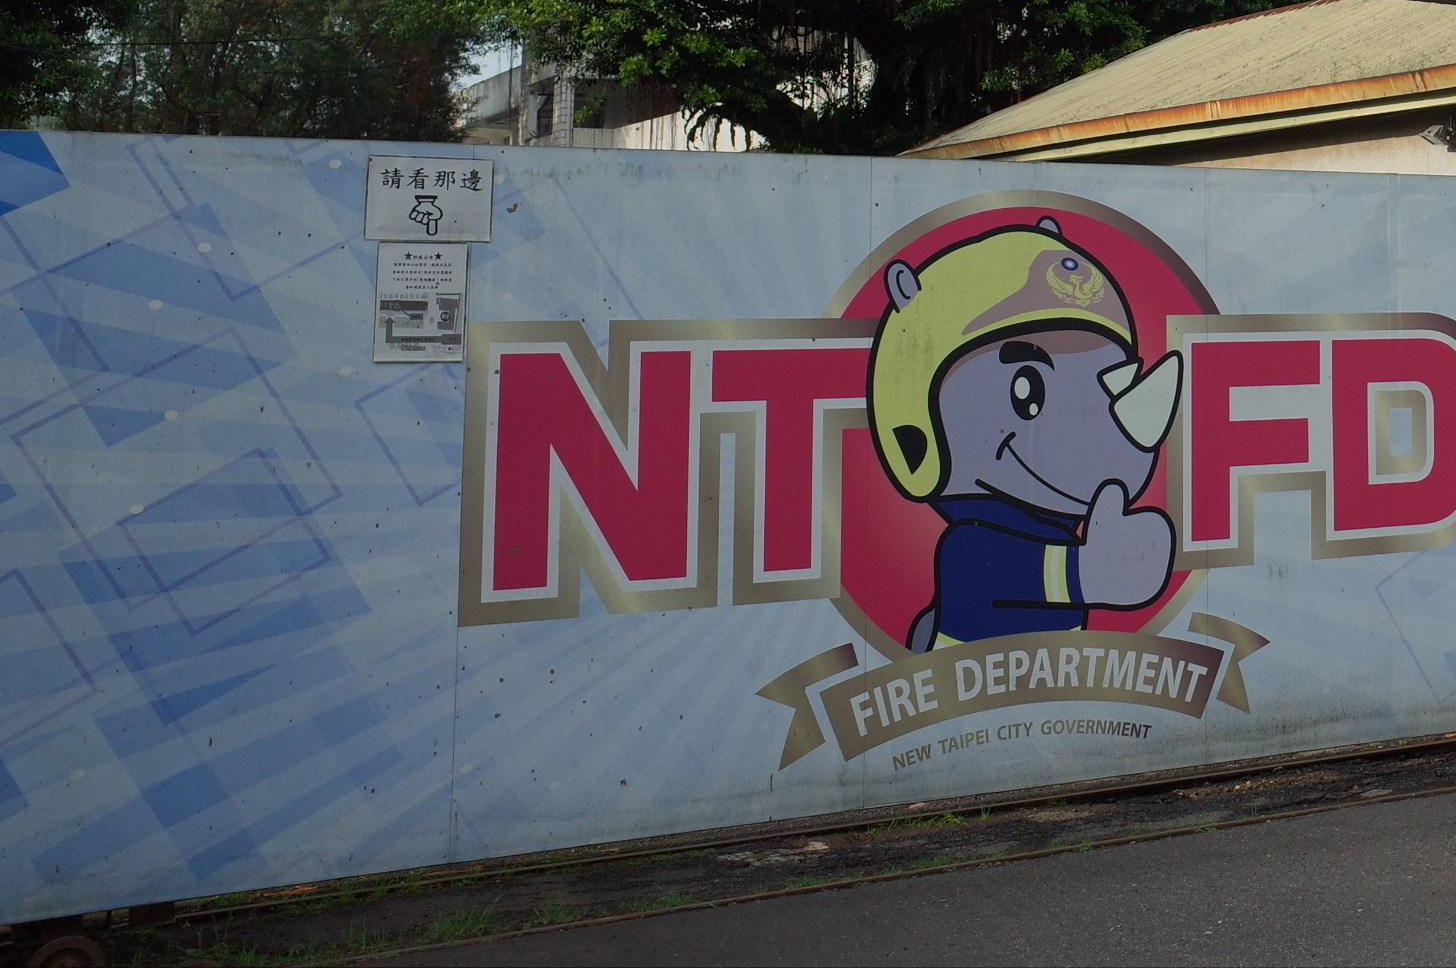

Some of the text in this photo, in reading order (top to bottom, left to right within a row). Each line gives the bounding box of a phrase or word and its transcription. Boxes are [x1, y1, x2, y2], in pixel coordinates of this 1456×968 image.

[380, 167, 483, 192] 請看那邊
[849, 646, 1209, 737] FIRE DEPARTMENT
[892, 719, 1153, 772] NEW TAIPEI CITY GOVERNMENT
